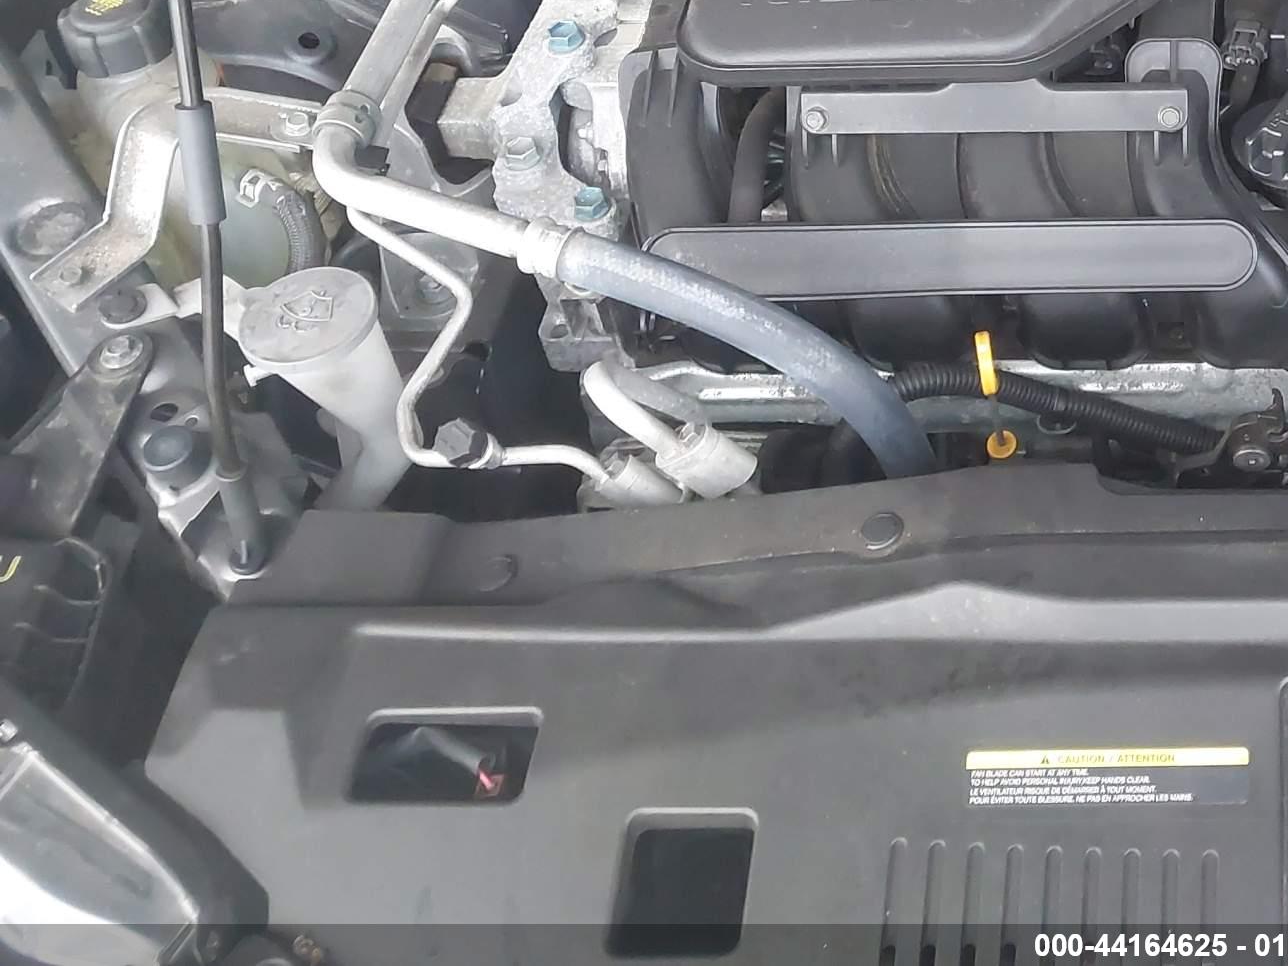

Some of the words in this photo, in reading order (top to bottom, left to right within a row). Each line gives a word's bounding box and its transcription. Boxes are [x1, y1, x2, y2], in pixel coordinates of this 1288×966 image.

[1058, 754, 1105, 764] CAUTION
[1117, 753, 1175, 763] ATTENTION
[1025, 769, 1046, 777] START
[970, 778, 980, 786] TO
[1021, 777, 1058, 786] PERSONAL
[1101, 776, 1126, 784] HANDS
[1106, 786, 1124, 794] TOUT
[969, 796, 990, 805] POUR
[1014, 796, 1037, 804] TOUTE
[1075, 795, 1086, 803] NE
[1086, 795, 1101, 803] PAS
[1101, 794, 1112, 803] EN
